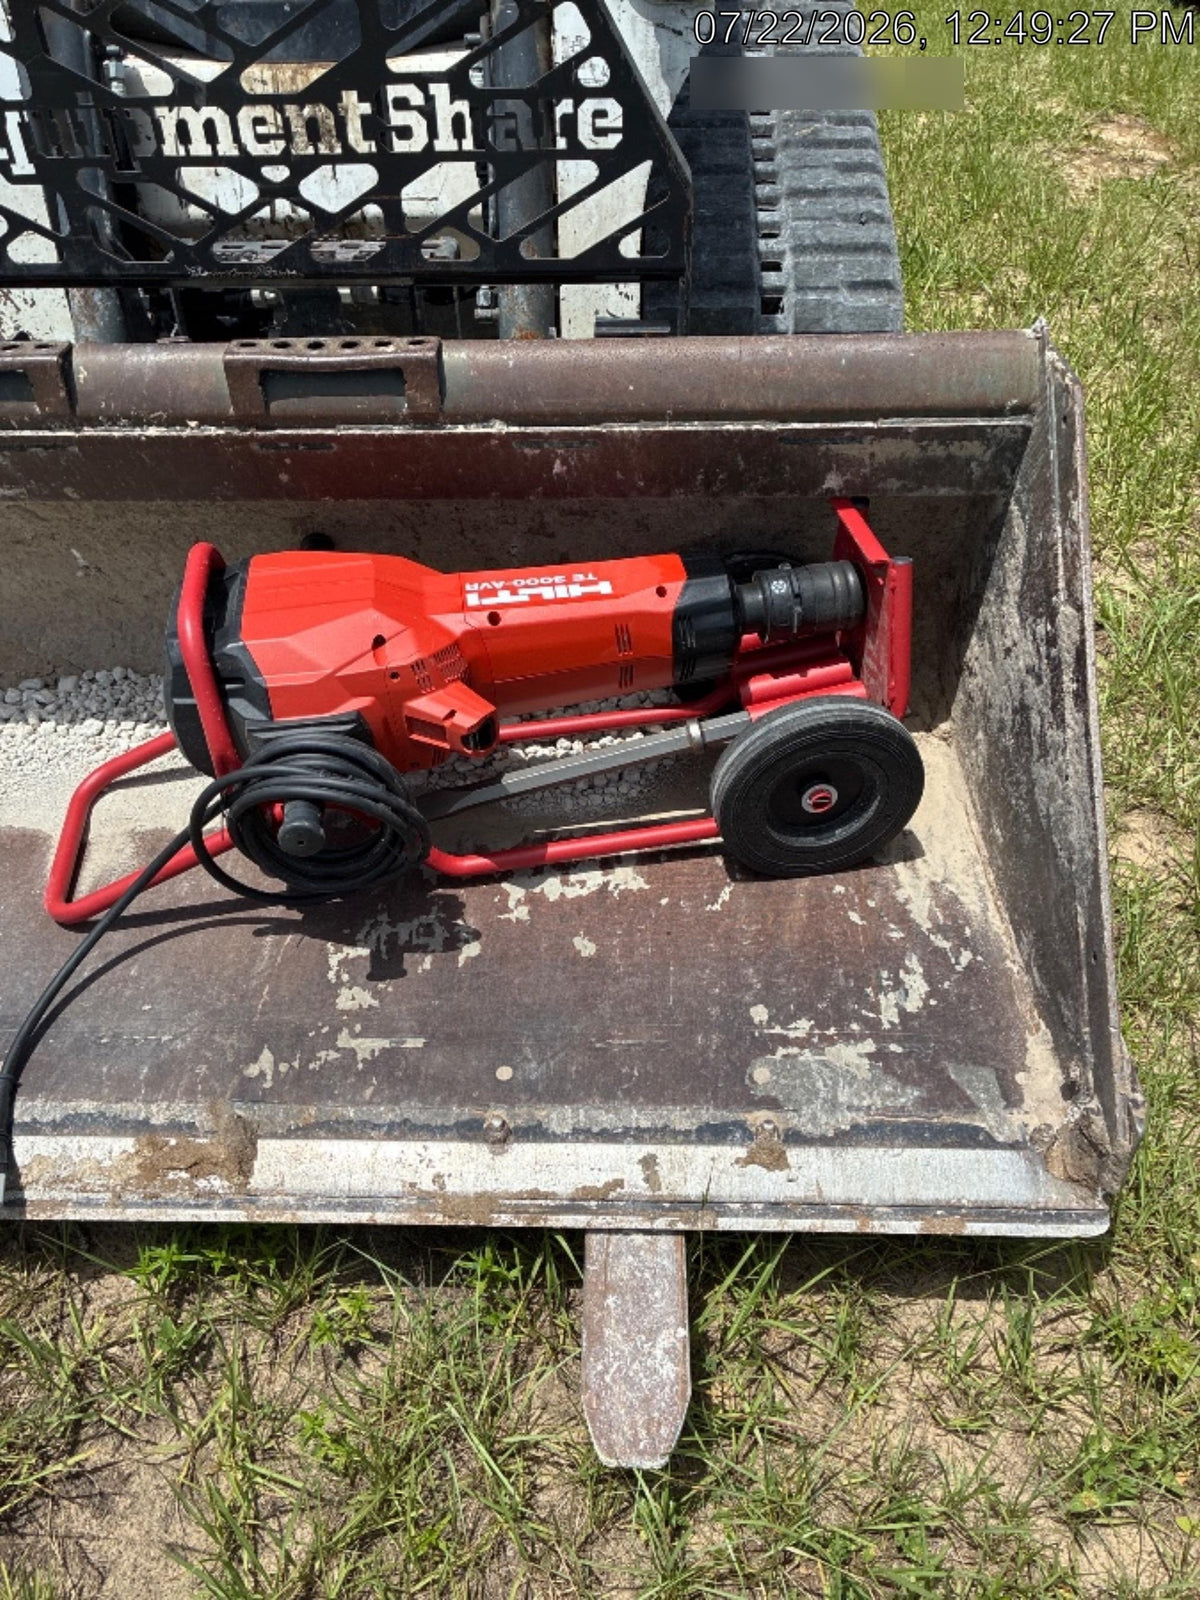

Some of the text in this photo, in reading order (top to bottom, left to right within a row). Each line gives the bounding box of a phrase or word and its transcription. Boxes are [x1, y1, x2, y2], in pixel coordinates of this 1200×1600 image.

[465, 572, 598, 591] TE 3000-AVR
[466, 581, 612, 606] HILTI
